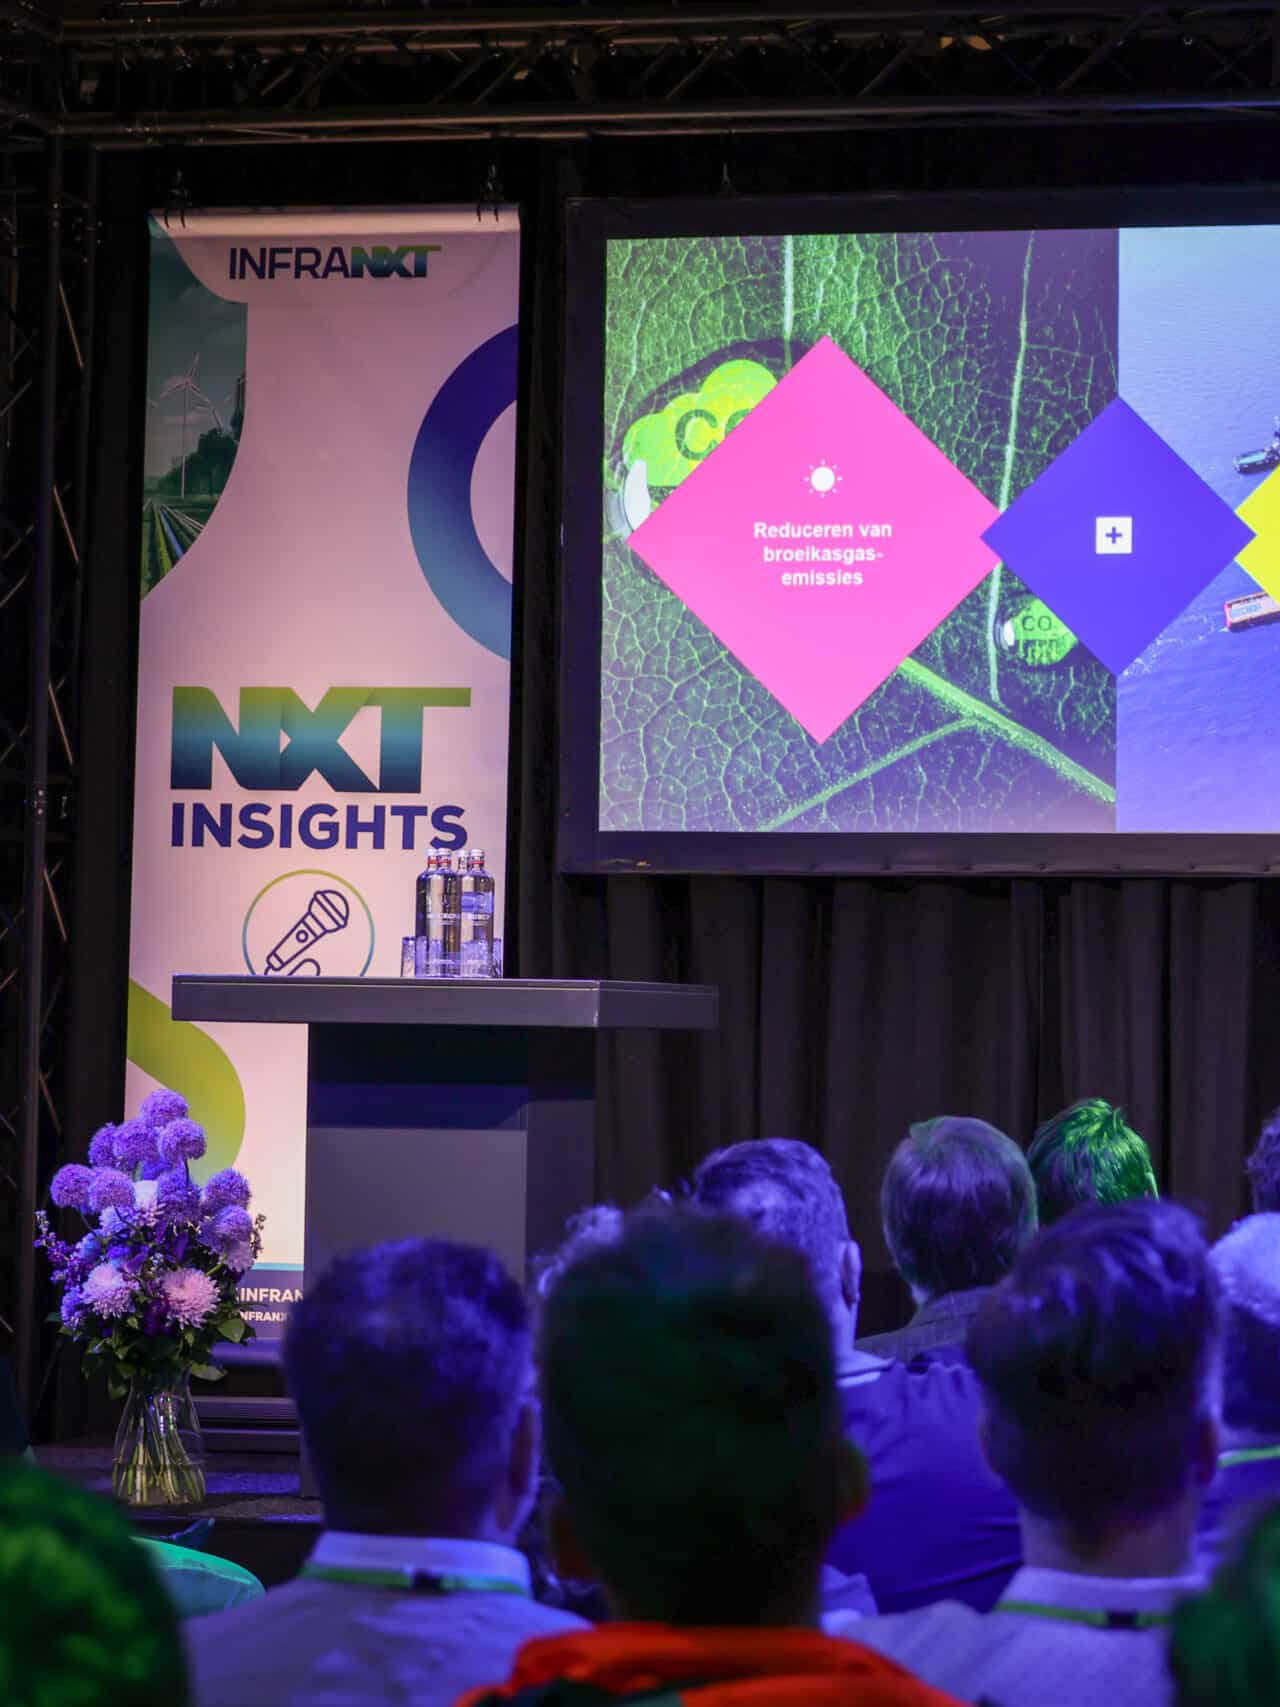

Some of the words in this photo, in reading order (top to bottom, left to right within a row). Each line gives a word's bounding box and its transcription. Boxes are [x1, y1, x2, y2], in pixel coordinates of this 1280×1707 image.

[229, 245, 441, 280] INFRANXT
[753, 522, 853, 538] Reduceren
[859, 524, 892, 537] van
[763, 546, 884, 564] broeikasgas-
[781, 569, 864, 586] emissies
[170, 686, 472, 793] NXT
[171, 802, 469, 851] INSIGHTS
